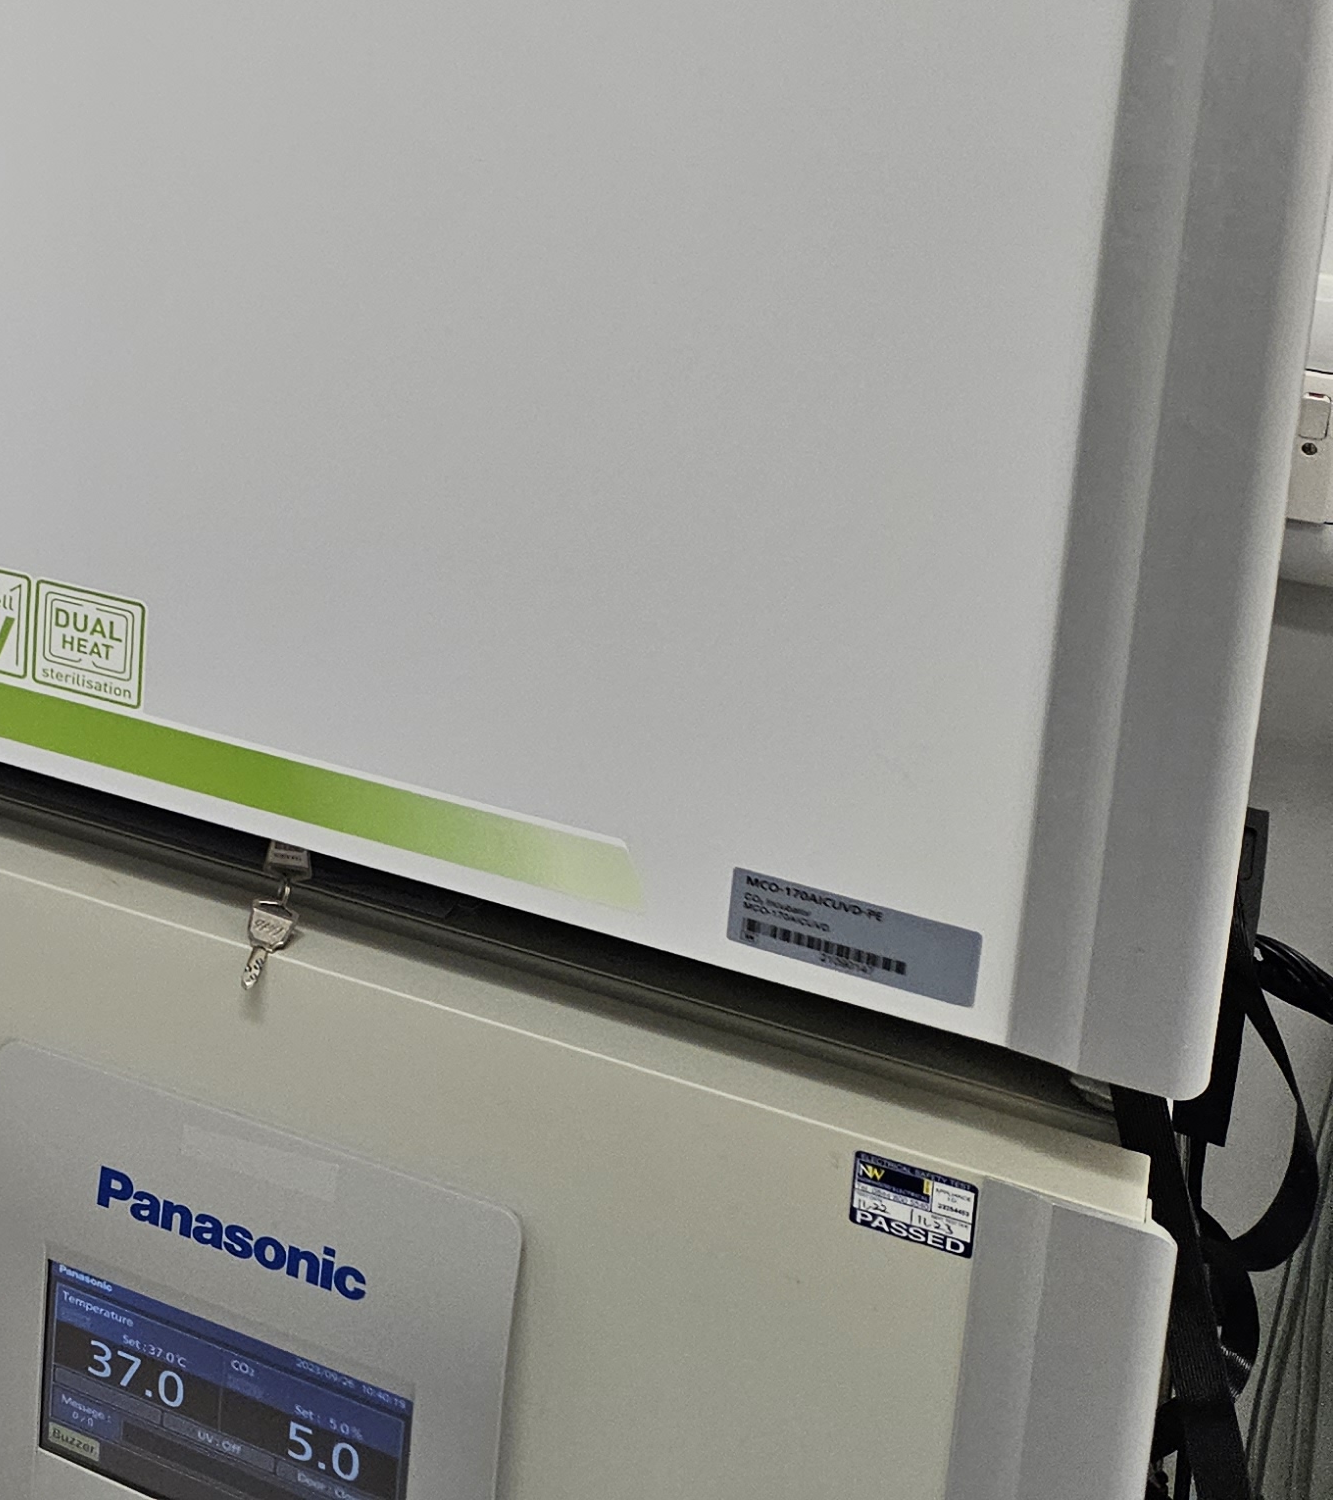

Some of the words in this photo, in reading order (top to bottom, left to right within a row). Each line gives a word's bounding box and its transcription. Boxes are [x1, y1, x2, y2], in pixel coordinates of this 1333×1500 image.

[54, 606, 123, 643] DUAL
[61, 633, 115, 661] HEAT
[41, 667, 133, 700] sterilisation
[96, 1164, 368, 1301] Panasonic
[856, 1209, 966, 1255] PASSED
[58, 1263, 113, 1293] Panasonic
[62, 1290, 134, 1327] Temperature
[87, 1339, 185, 1409] 37.0
[51, 1425, 96, 1455] Buzzer
[287, 1420, 360, 1482] 5.0
